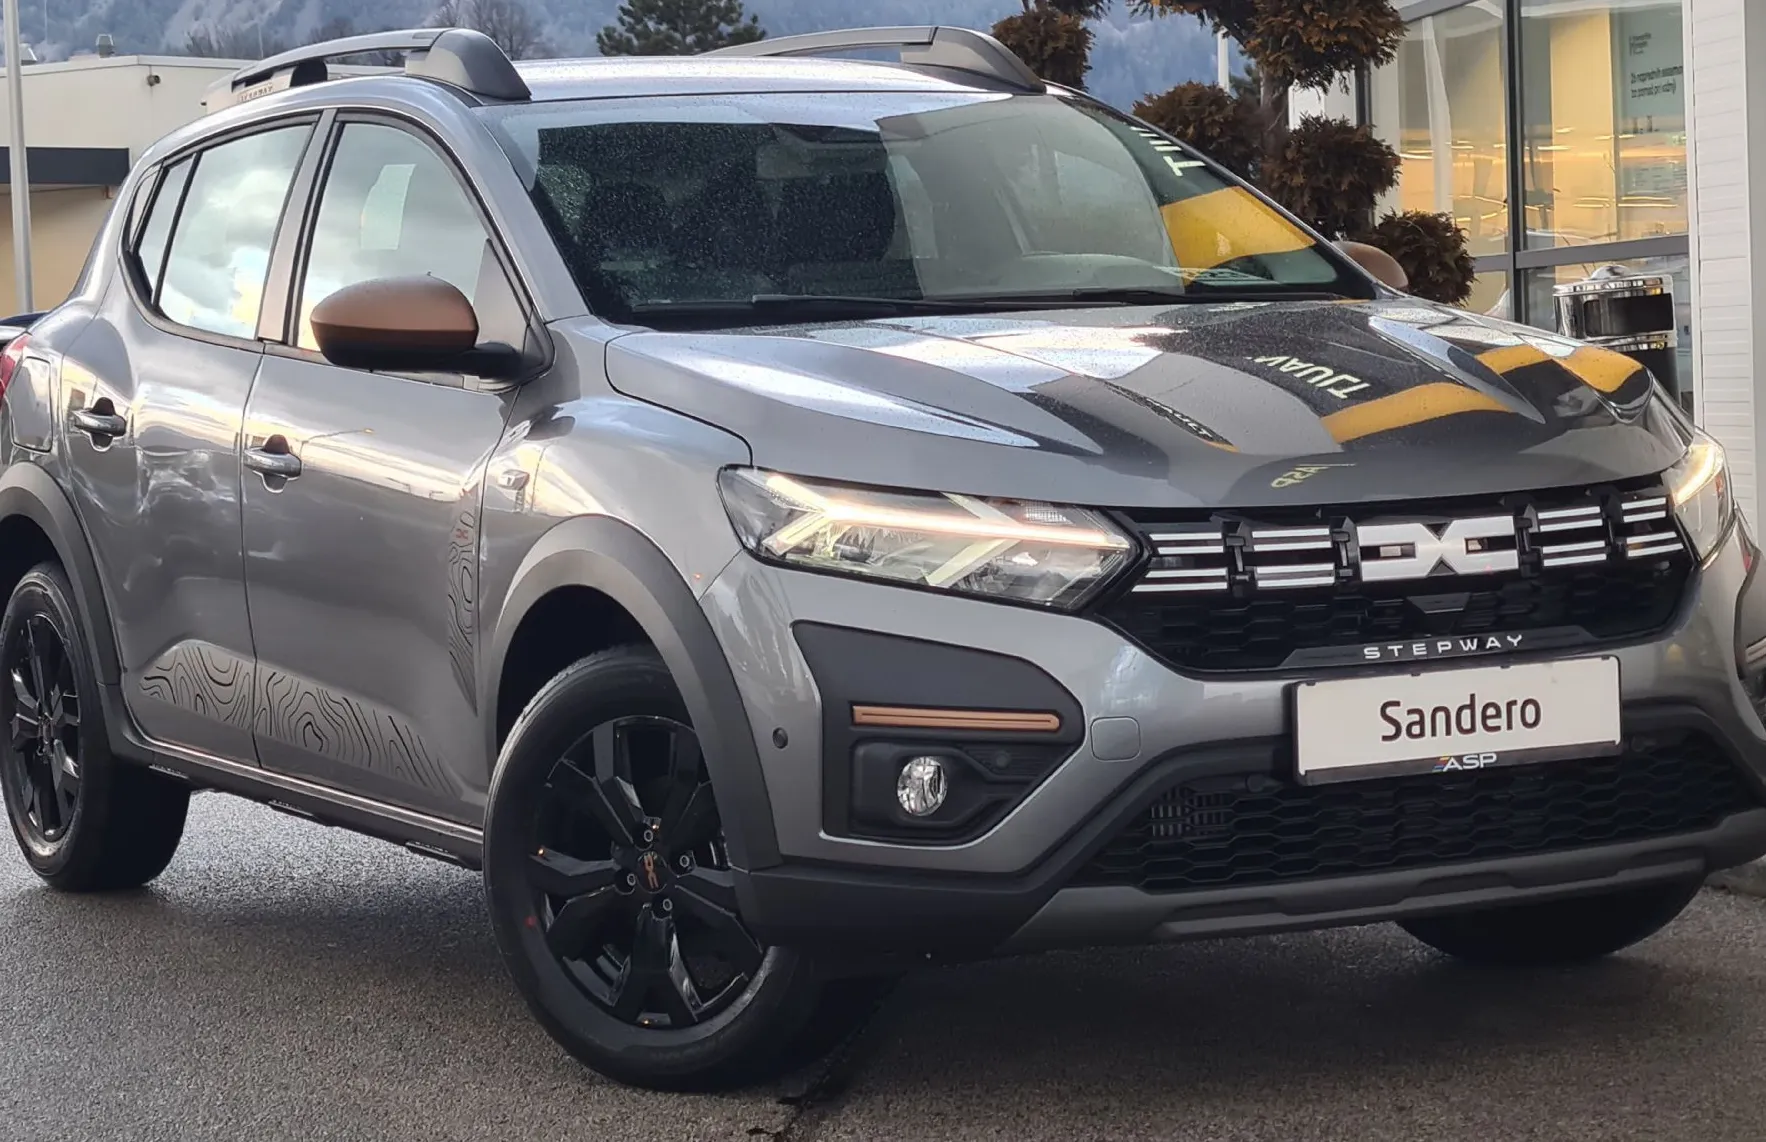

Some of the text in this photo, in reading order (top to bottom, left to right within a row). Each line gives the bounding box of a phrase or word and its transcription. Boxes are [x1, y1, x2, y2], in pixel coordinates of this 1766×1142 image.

[1363, 634, 1523, 659] STEPWAY
[1379, 693, 1541, 742] Sandero
[1442, 752, 1497, 772] ASP
